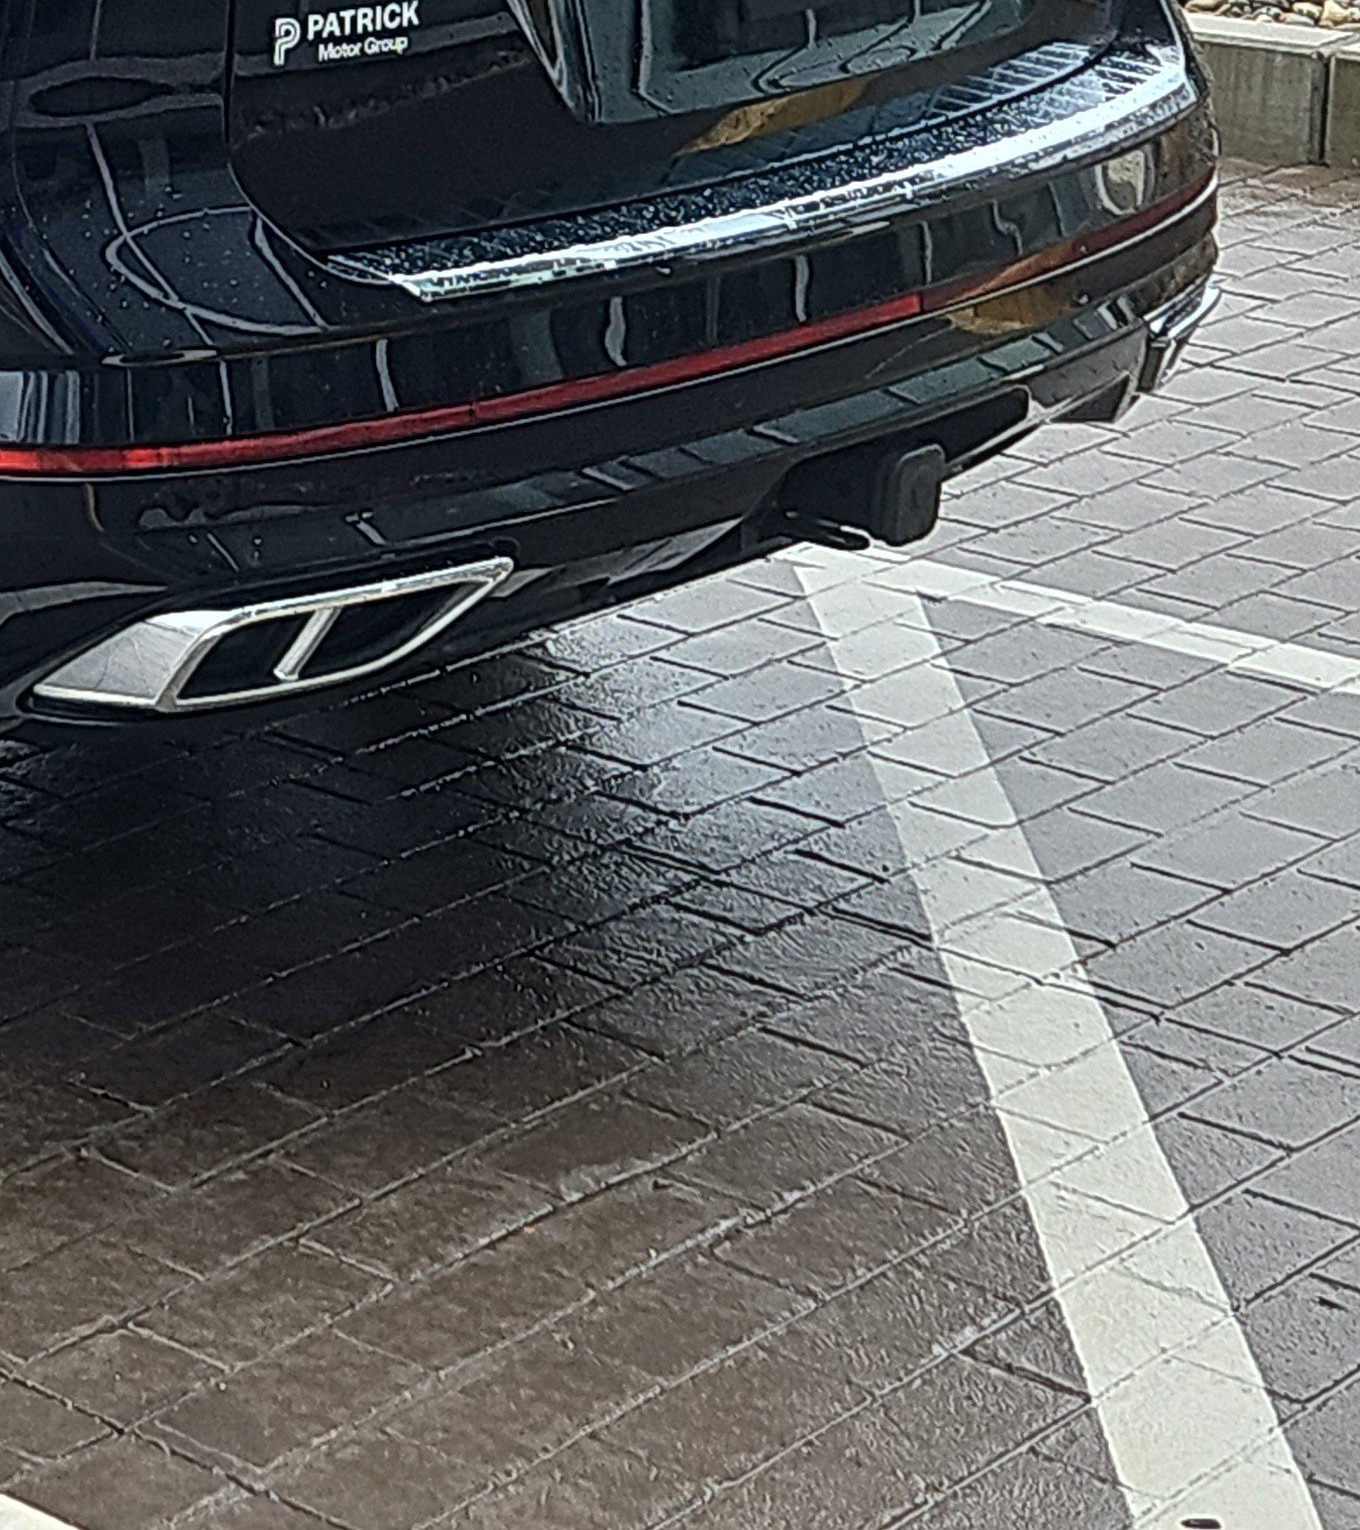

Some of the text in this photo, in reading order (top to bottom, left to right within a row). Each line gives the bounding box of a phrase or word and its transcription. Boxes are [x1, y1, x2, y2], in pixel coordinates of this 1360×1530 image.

[307, 0, 421, 41] PATRICK
[318, 35, 409, 62] Motor Group
